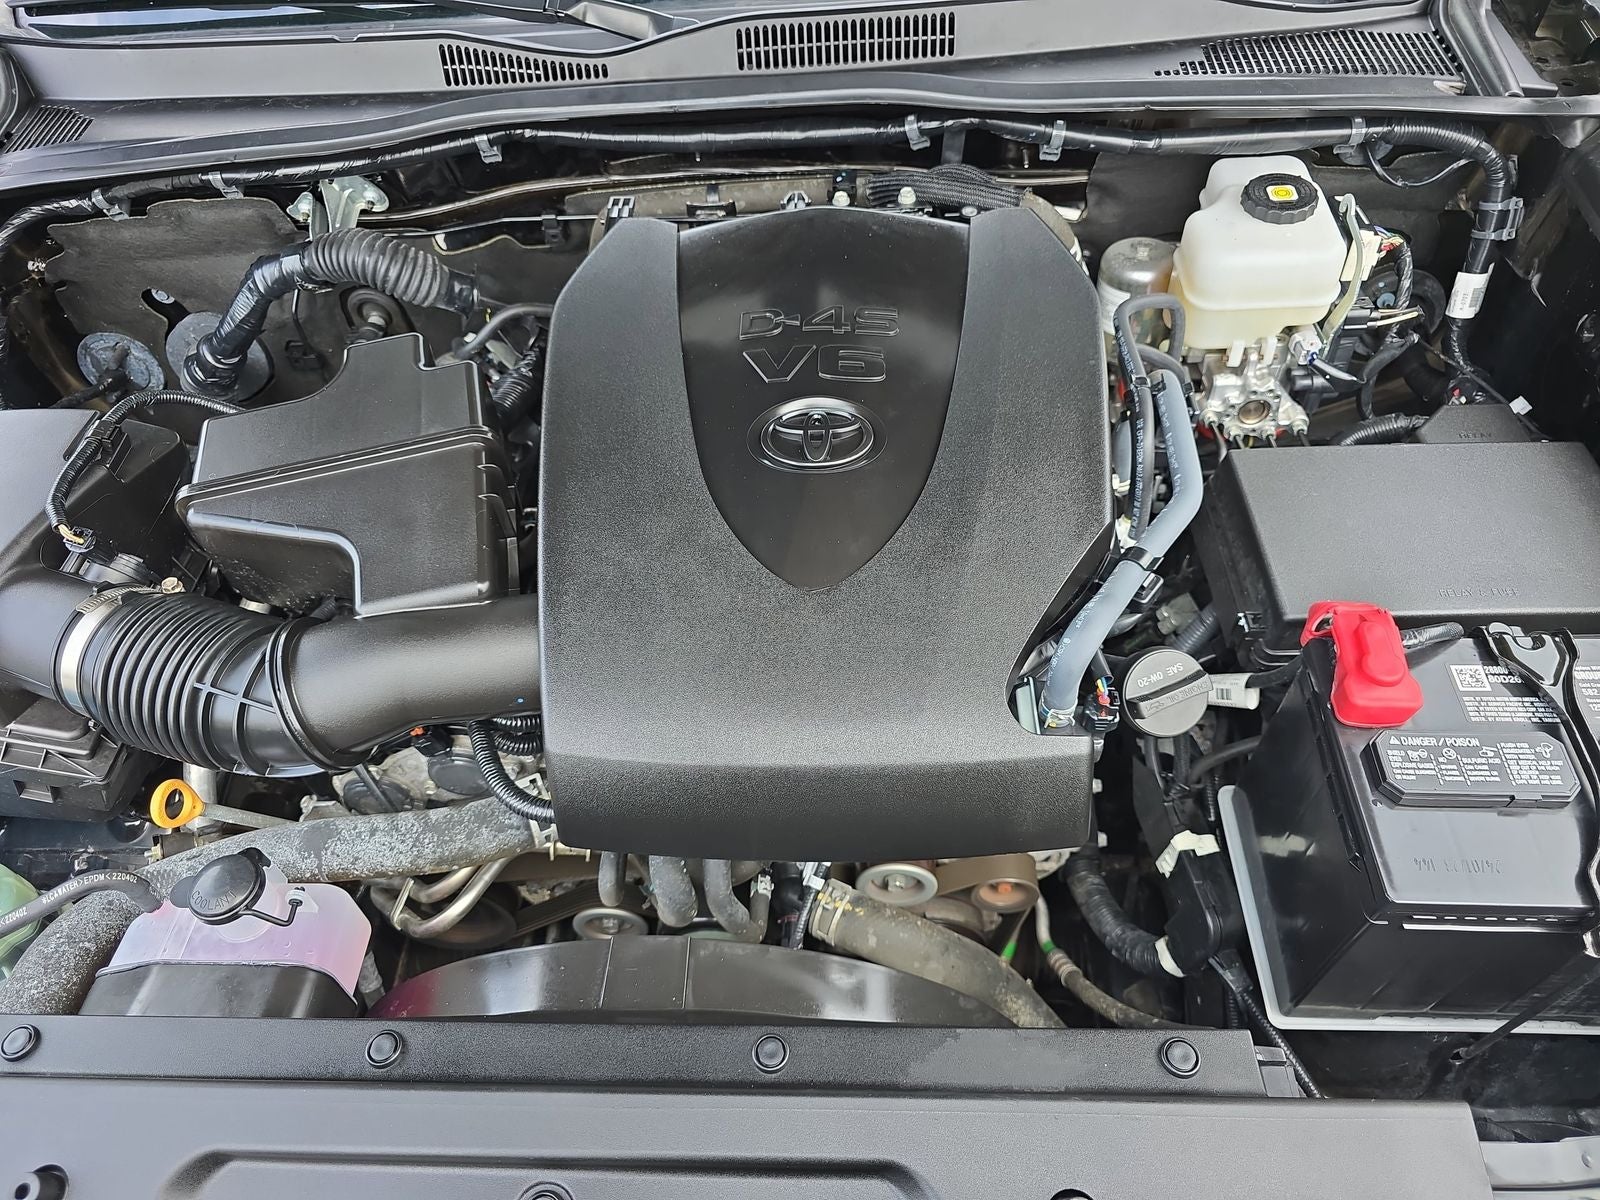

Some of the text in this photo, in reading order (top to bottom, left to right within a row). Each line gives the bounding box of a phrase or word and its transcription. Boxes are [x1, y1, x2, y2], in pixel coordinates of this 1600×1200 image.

[738, 304, 900, 341] D-4S
[742, 343, 887, 384] V6
[1438, 588, 1474, 599] RELAY
[1490, 588, 1520, 598] FUSE
[1137, 662, 1184, 688] SAE 0W-20
[1487, 675, 1525, 684] 80D26
[1400, 736, 1480, 747] DANGER / POISON
[191, 889, 238, 911] COOLANT
